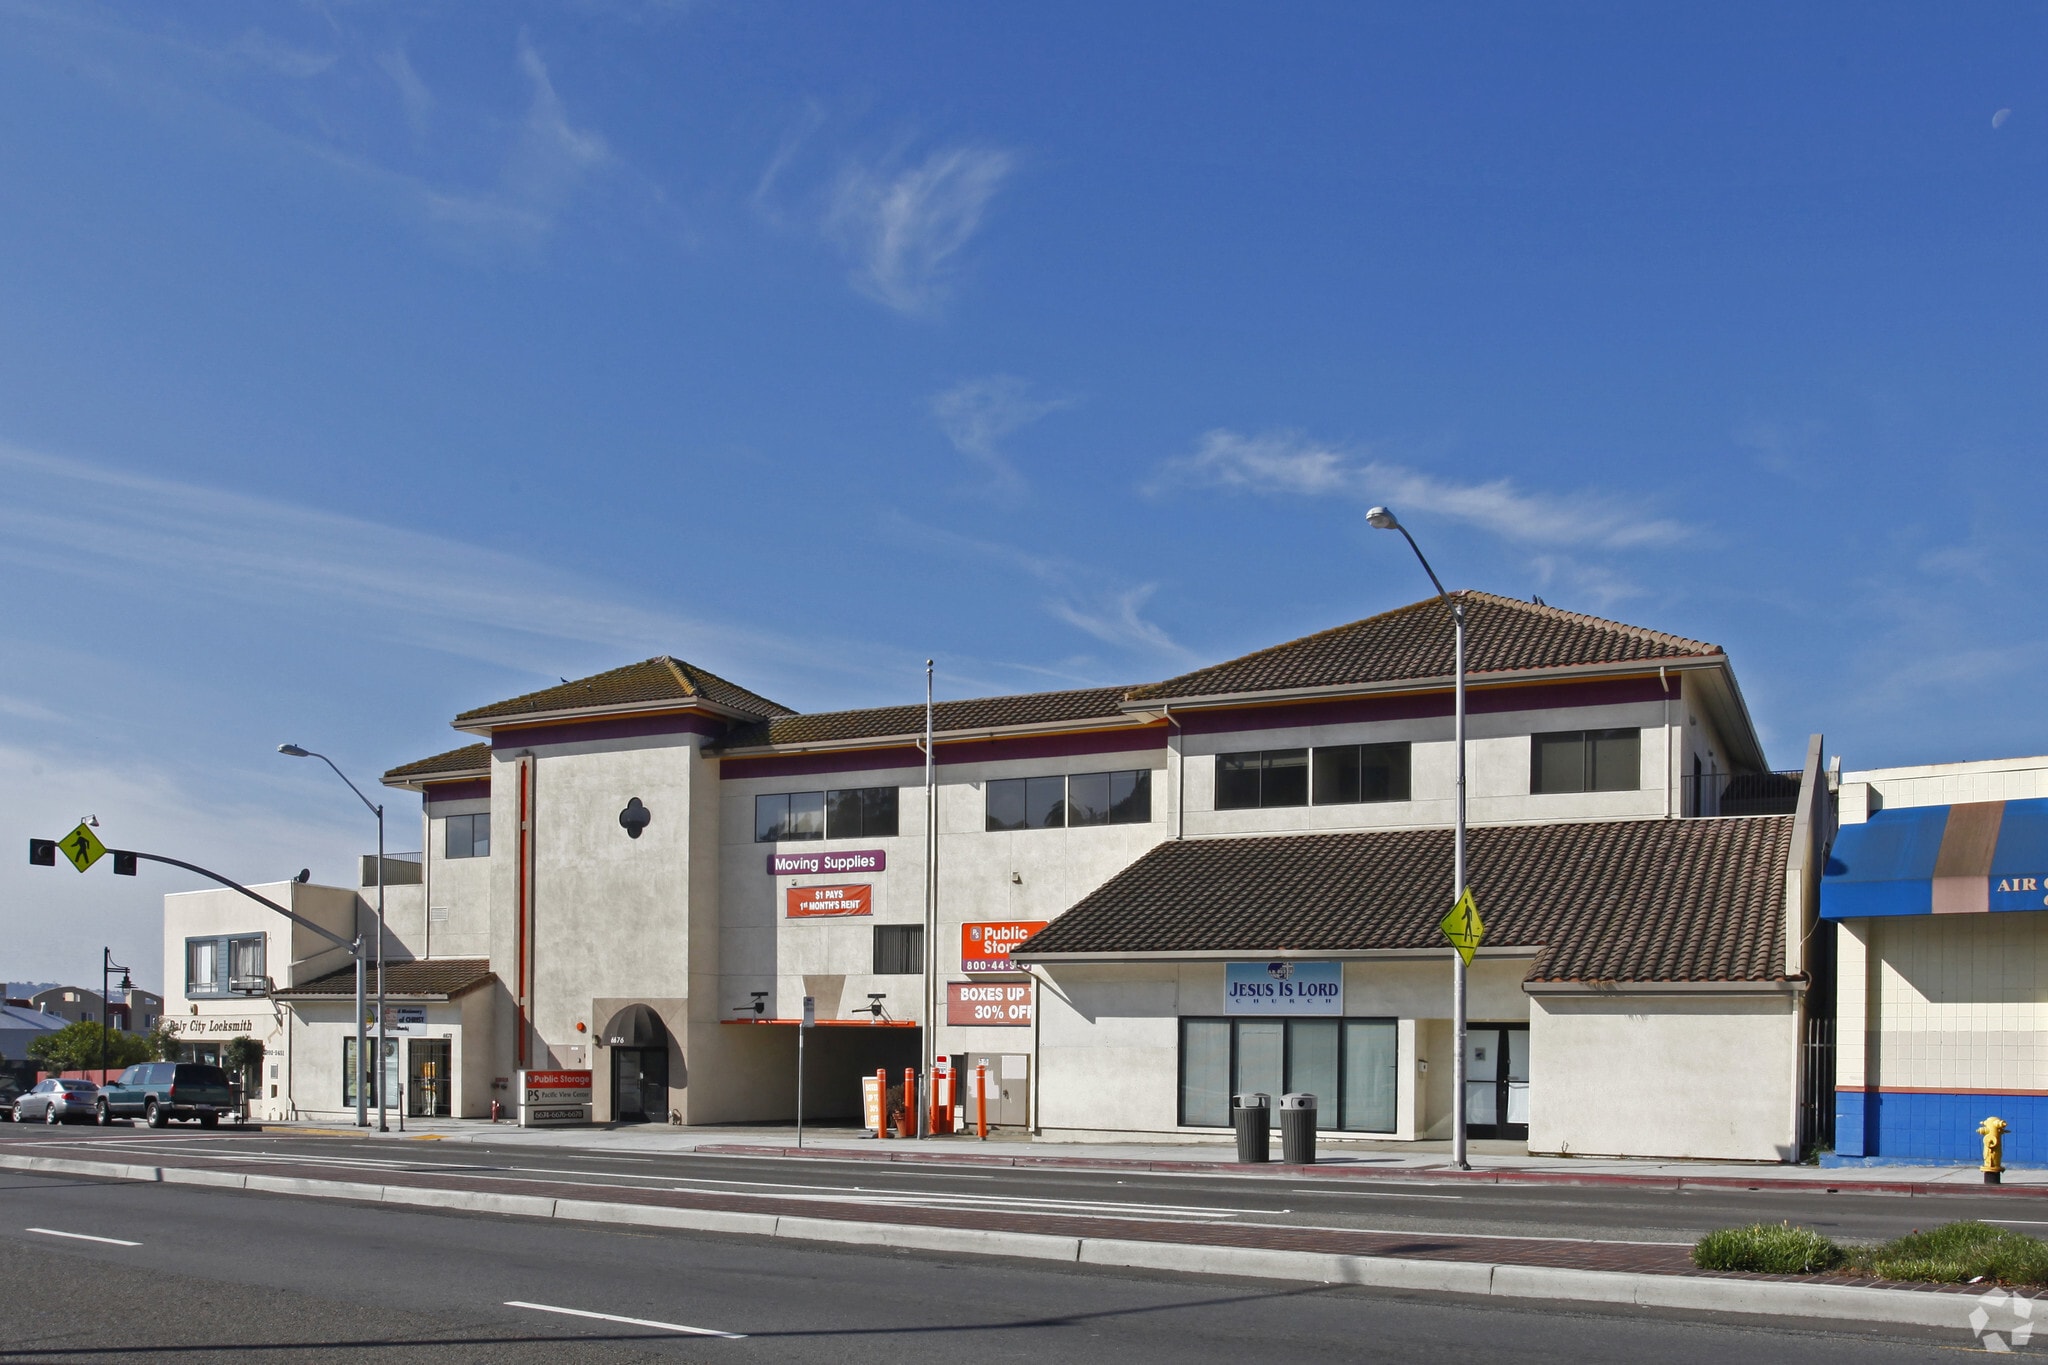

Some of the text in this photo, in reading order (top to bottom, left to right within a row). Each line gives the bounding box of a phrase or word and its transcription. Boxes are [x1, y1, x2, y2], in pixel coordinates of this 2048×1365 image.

[775, 855, 876, 872] Moving Supplies
[1997, 878, 2038, 892] AIR
[815, 889, 844, 900] $1 PAYS
[808, 900, 840, 910] MONTH'S
[840, 899, 861, 909] RENT
[984, 926, 1028, 940] Public
[984, 940, 1022, 954] Stor
[960, 987, 1003, 1001] BOXES
[1006, 987, 1025, 1001] UP
[1229, 981, 1338, 997] JESUS IS LORD
[974, 1005, 1004, 1019] 30%
[189, 1020, 207, 1034] City
[209, 1019, 253, 1032] Locksmith
[534, 1075, 559, 1083] Public
[560, 1075, 590, 1085] Storage
[527, 1089, 540, 1102] PS
